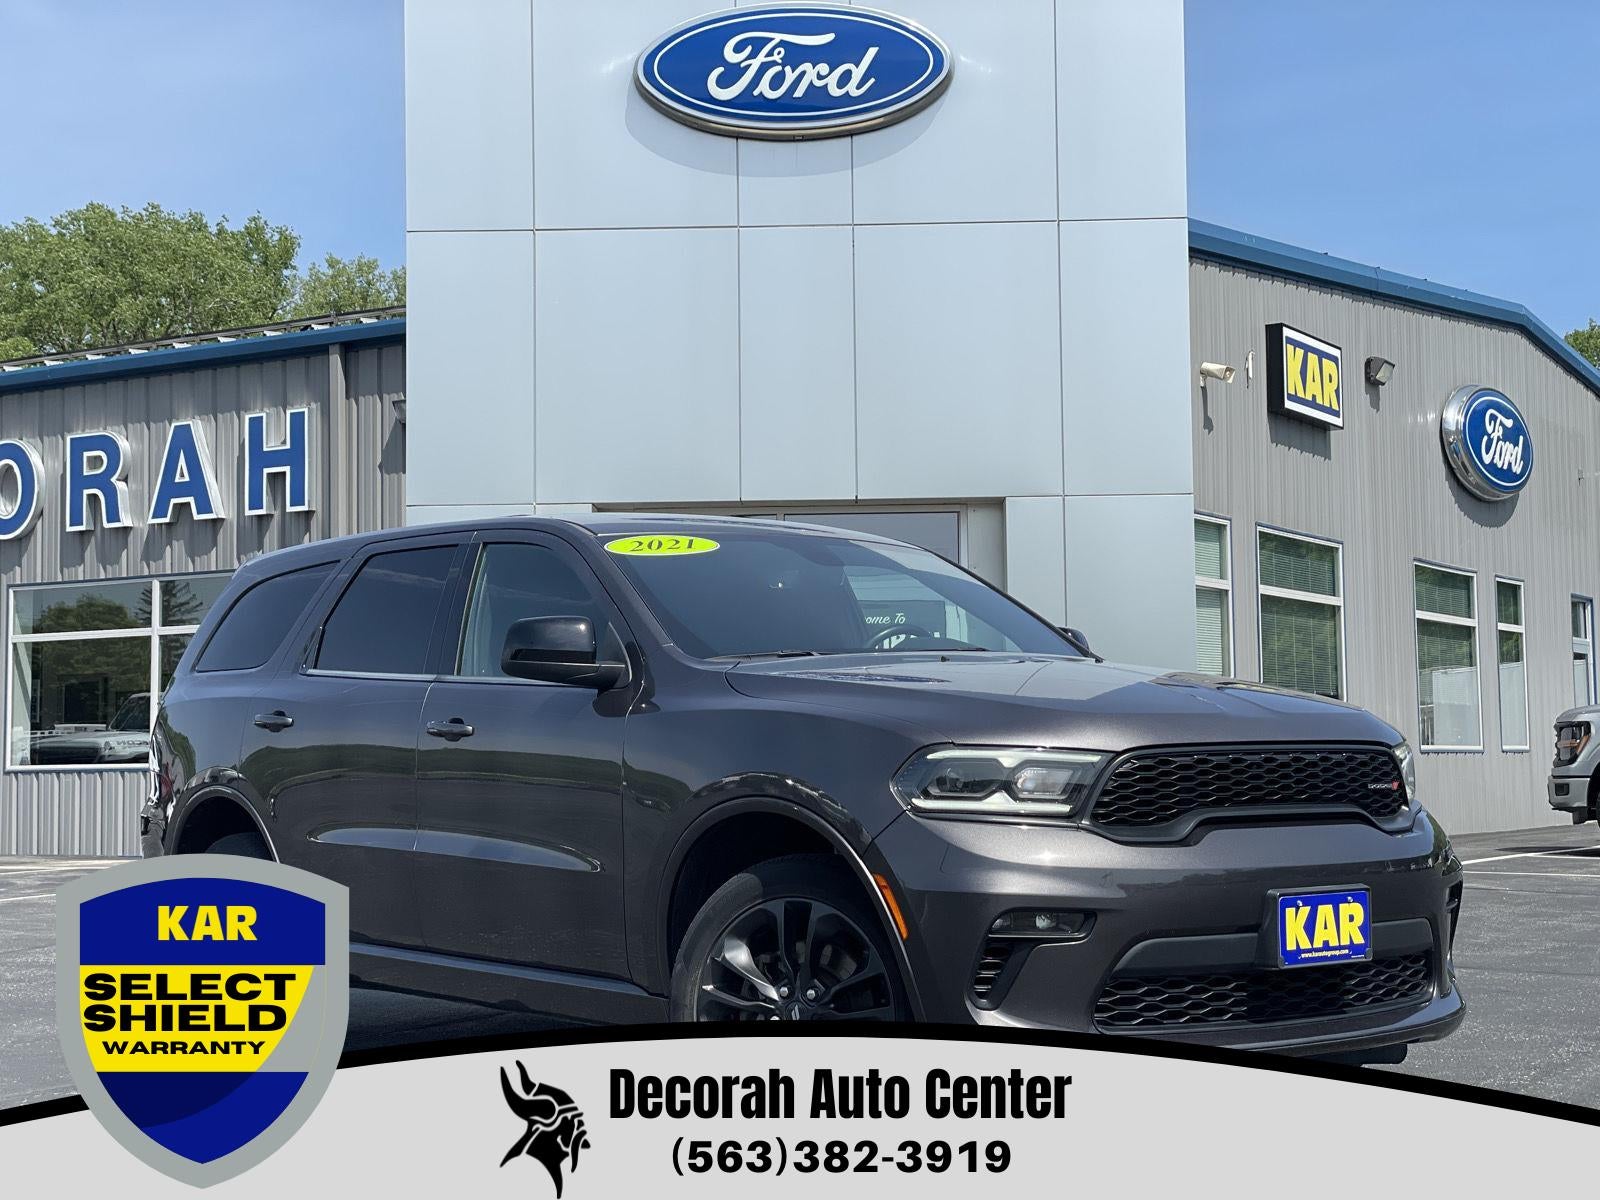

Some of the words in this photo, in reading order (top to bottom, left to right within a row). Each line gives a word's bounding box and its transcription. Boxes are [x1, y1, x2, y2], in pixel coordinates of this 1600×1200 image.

[706, 31, 880, 101] Ford
[1286, 343, 1340, 411] KAR
[1481, 408, 1524, 475] Ford
[630, 538, 694, 552] 2021
[865, 615, 891, 625] ome
[894, 612, 906, 625] To
[1285, 902, 1366, 951] KAR
